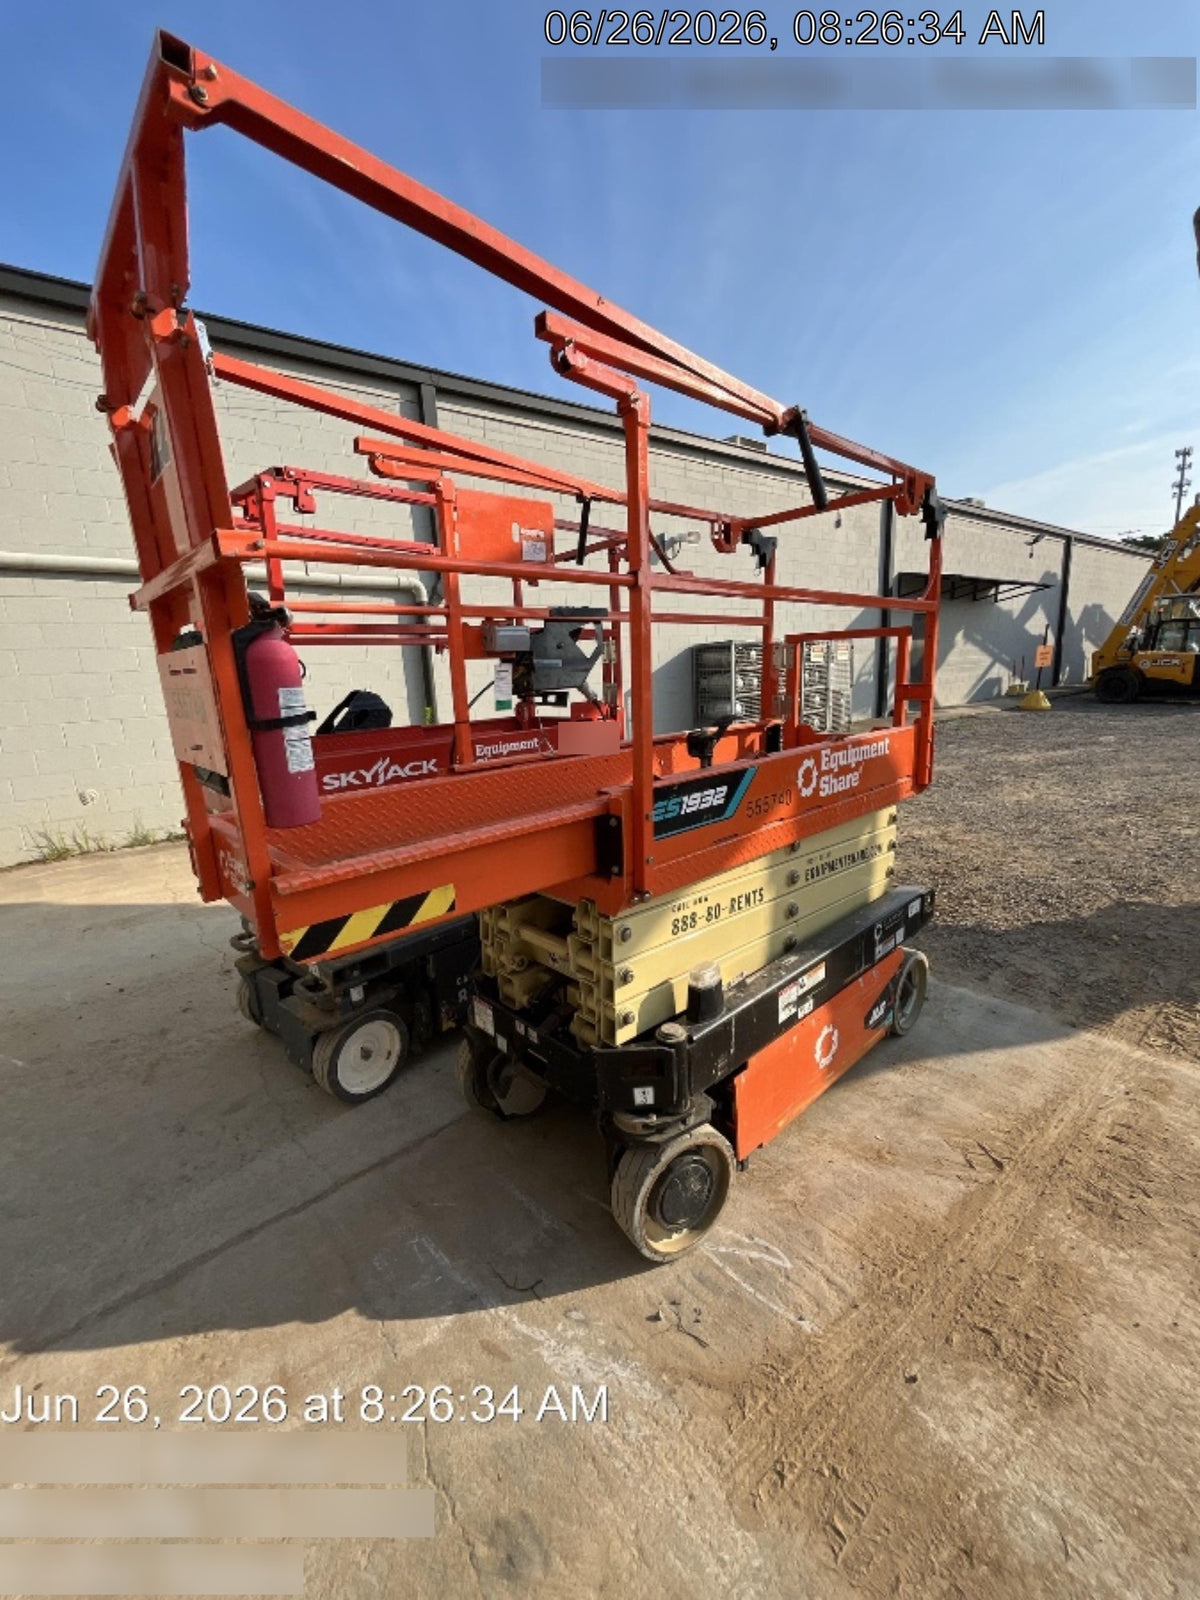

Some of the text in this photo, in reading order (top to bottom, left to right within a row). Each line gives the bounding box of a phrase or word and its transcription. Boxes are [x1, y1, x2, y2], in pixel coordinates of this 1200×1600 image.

[475, 737, 540, 758] Equipment
[820, 738, 890, 772] Equipment
[322, 757, 438, 791] SKYJACK
[819, 769, 861, 797] Share
[652, 785, 728, 823] ES1932
